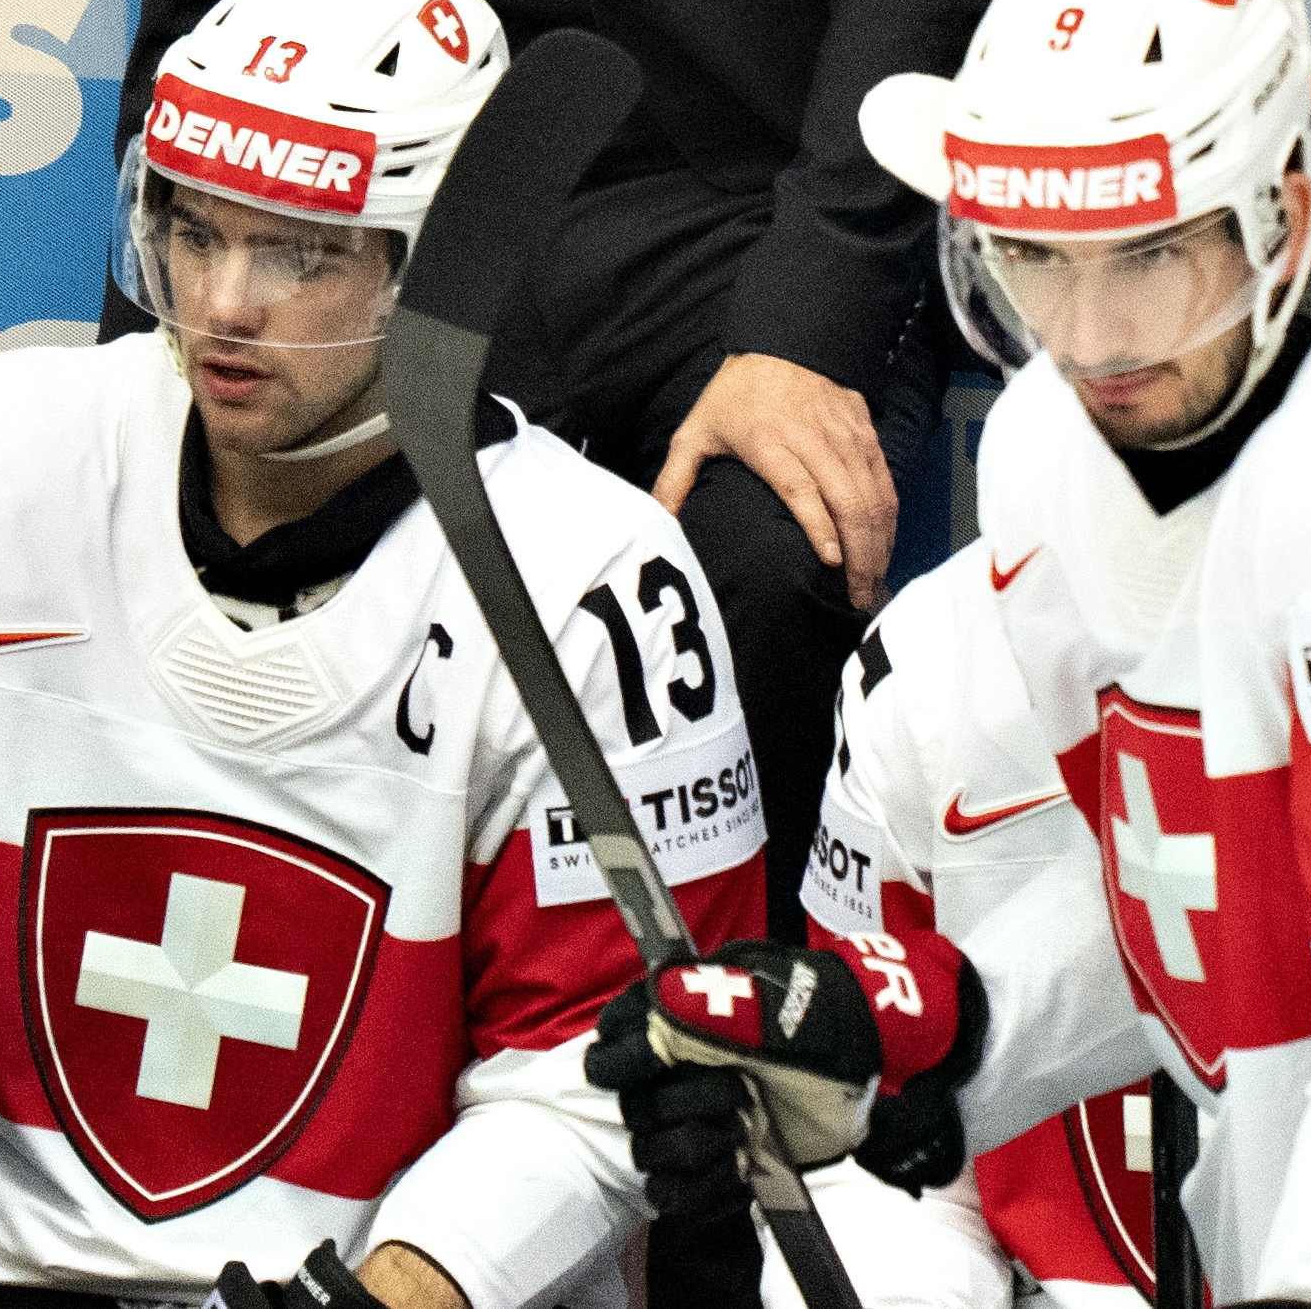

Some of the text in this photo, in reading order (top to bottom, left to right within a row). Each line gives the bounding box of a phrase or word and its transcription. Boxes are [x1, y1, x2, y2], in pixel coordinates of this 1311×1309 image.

[1048, 7, 1085, 52] 9
[242, 35, 307, 84] 13
[150, 100, 362, 192] DENNER
[953, 158, 1165, 211] DENNER
[579, 555, 717, 748] 13
[640, 749, 756, 831] TISSOT
[650, 824, 720, 855] ATCHES
